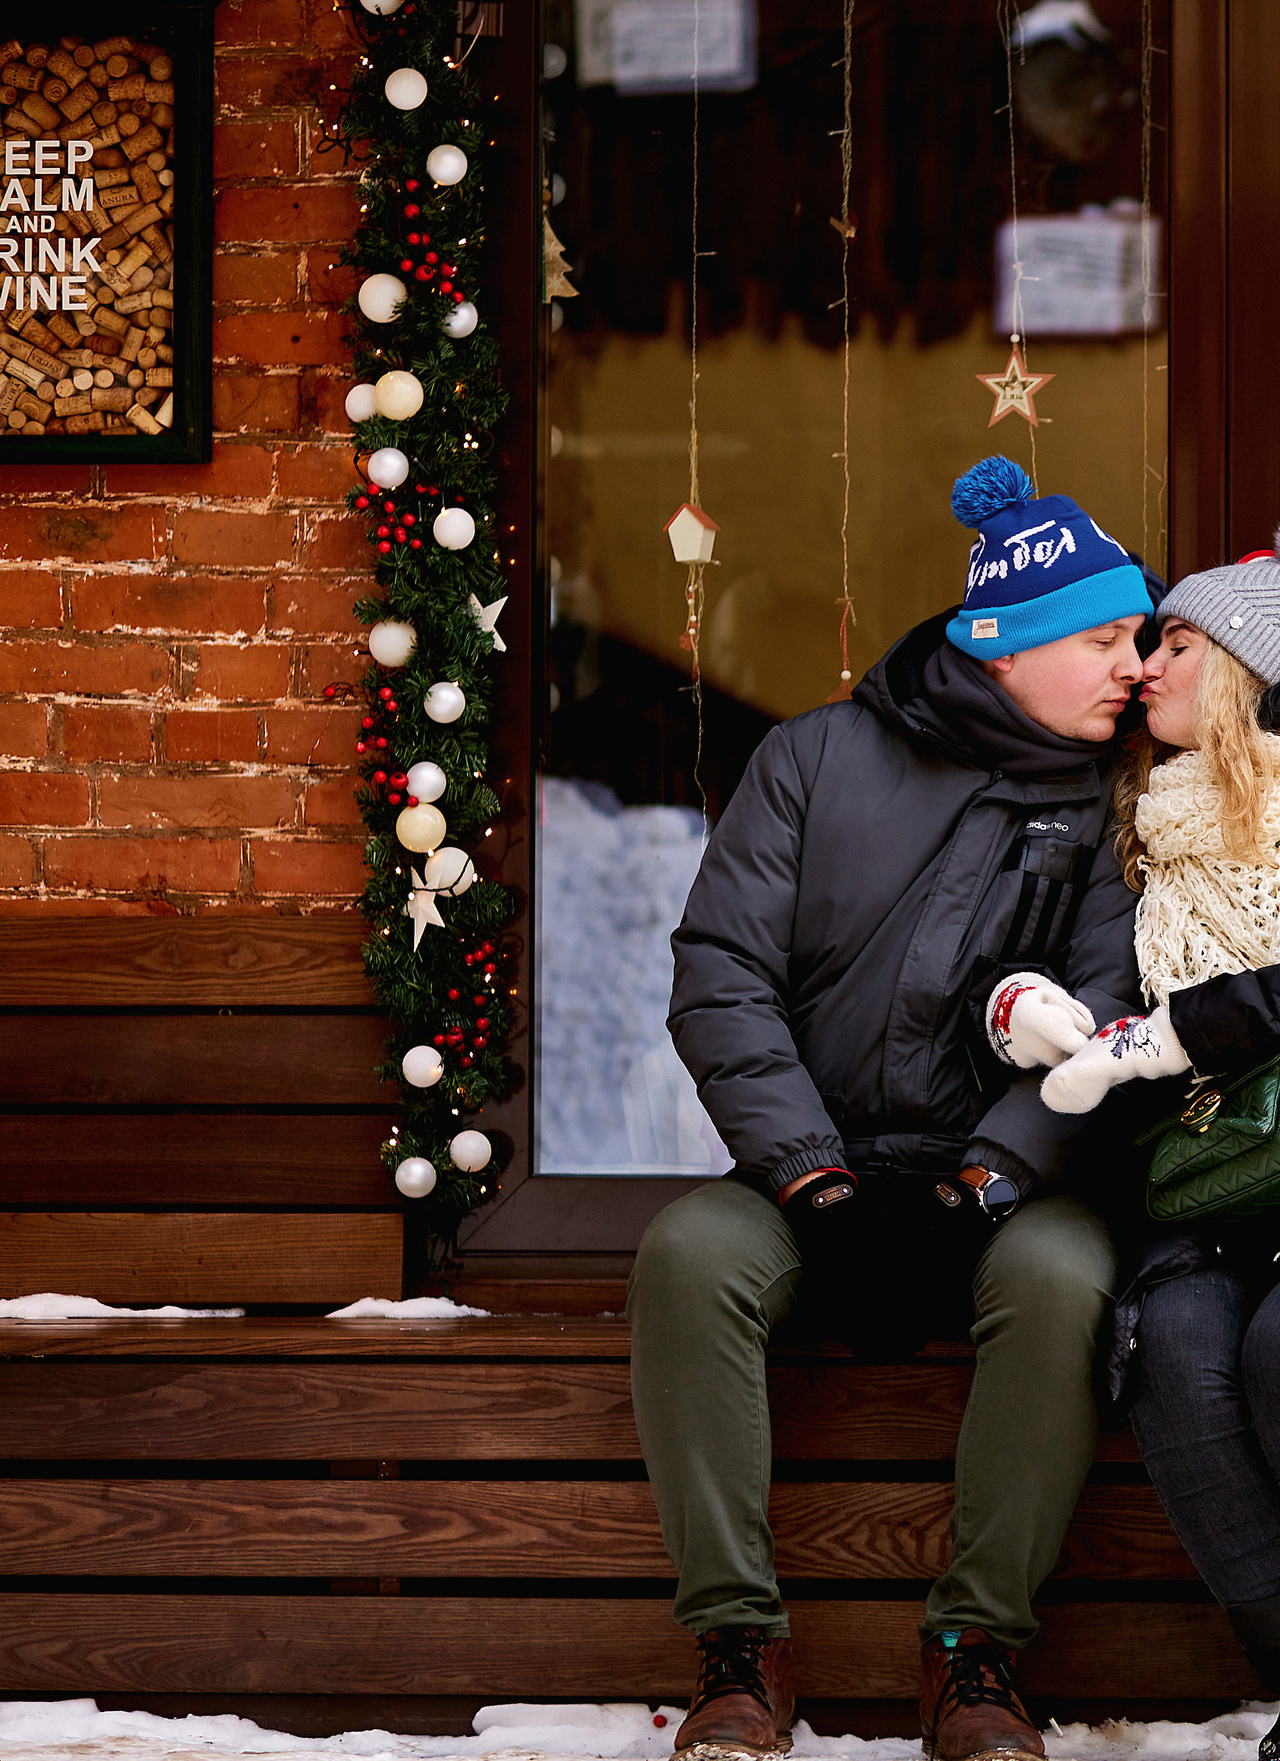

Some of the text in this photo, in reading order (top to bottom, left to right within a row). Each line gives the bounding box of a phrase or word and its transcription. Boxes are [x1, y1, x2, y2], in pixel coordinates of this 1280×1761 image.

[0, 178, 94, 212] ALM
[5, 215, 56, 233] AND
[0, 276, 88, 311] INE
